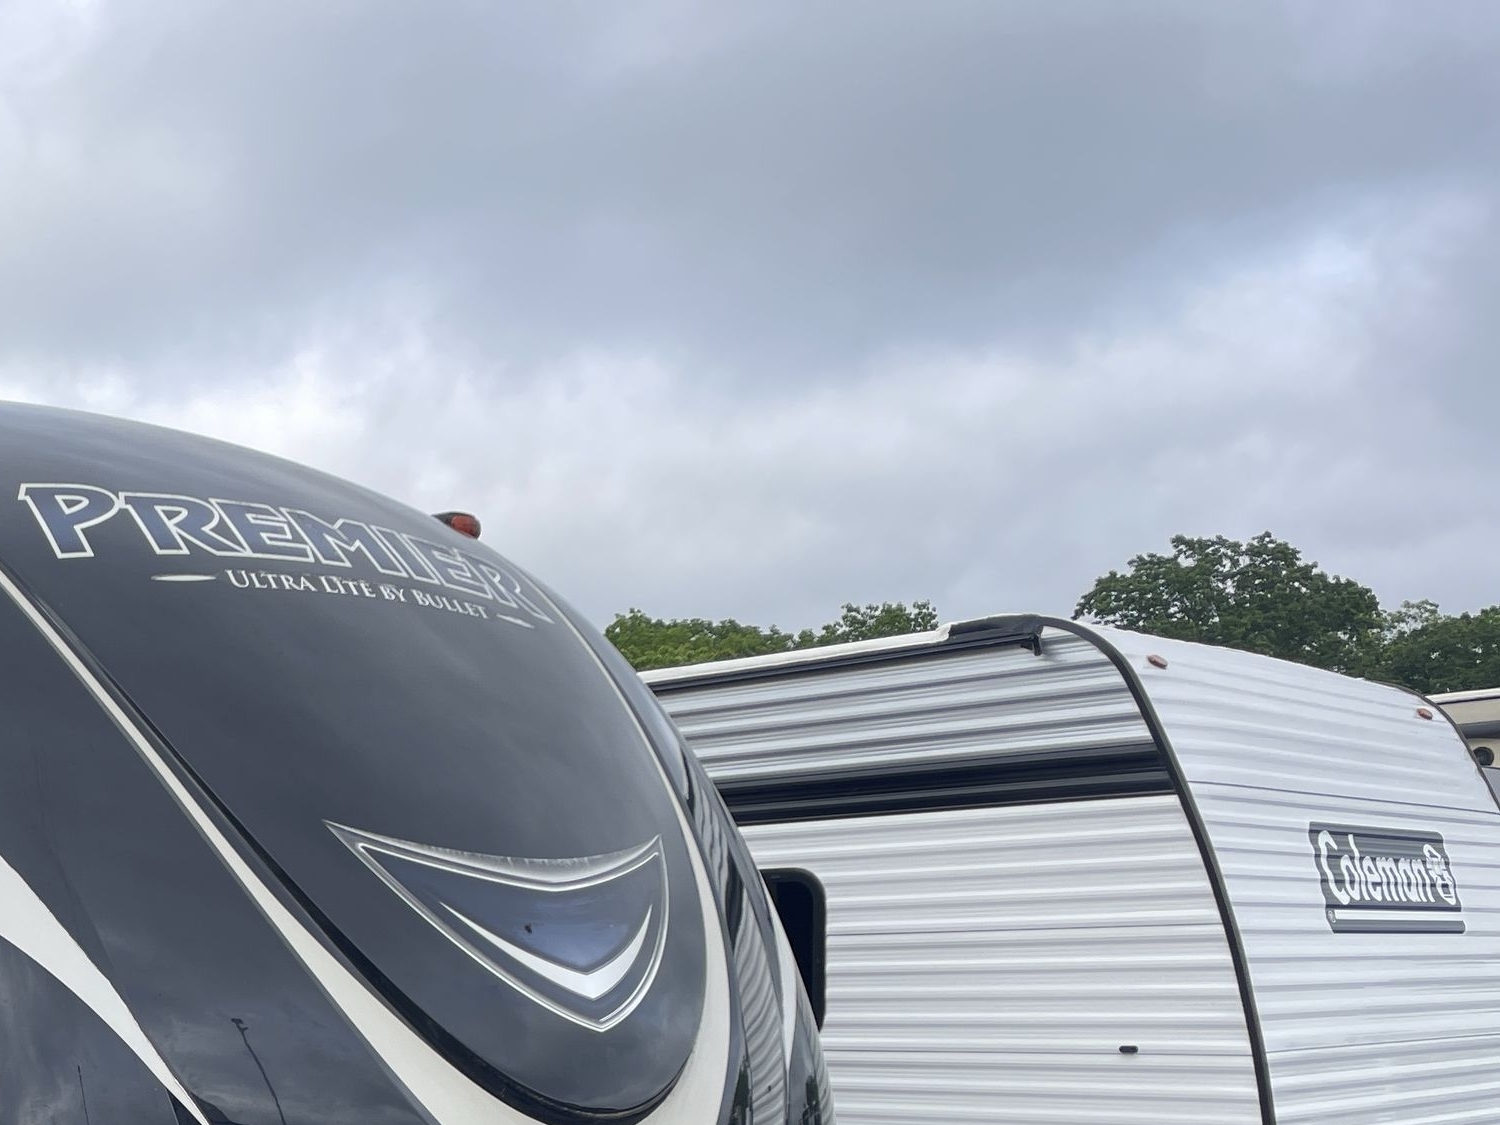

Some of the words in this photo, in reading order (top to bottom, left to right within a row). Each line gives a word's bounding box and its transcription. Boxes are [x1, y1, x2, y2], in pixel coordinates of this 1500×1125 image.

[17, 482, 555, 625] PREMIER
[224, 568, 317, 593] ULTRA
[319, 575, 376, 599] LITE
[378, 583, 407, 603] BY
[411, 588, 489, 619] BULLET
[1317, 829, 1436, 906] Coleman
